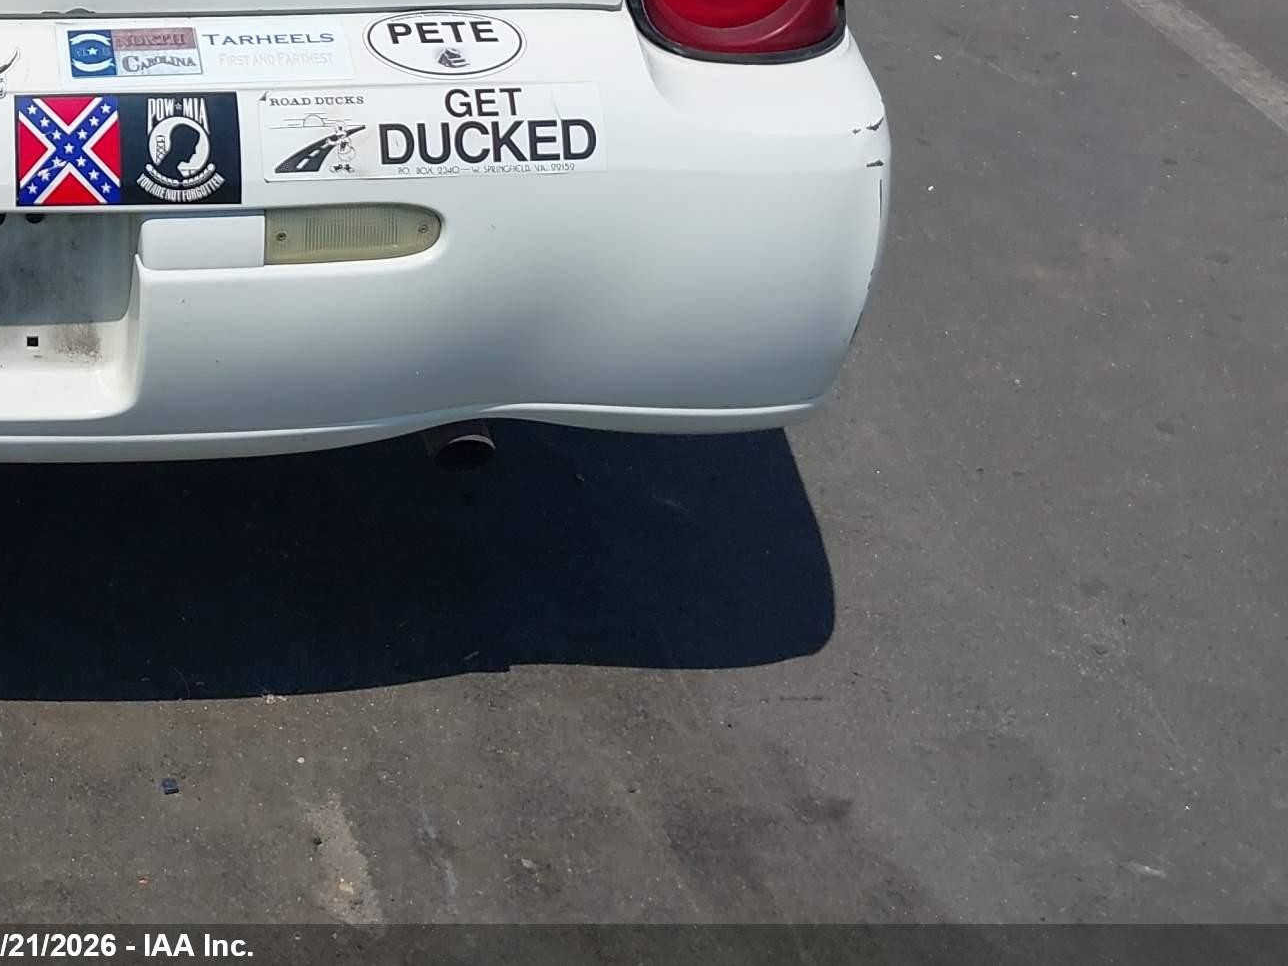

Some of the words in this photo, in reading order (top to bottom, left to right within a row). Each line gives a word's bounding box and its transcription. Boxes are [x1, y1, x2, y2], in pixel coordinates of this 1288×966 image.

[116, 32, 187, 48] NORTH
[201, 33, 335, 46] TARHEELS
[387, 20, 499, 45] PETE
[269, 96, 312, 107] ROAD
[314, 95, 365, 106] DUCKS
[444, 87, 522, 118] GET
[147, 98, 175, 135] POW
[182, 97, 210, 135] MIA
[378, 118, 597, 166] DUCKED
[550, 162, 575, 172] 22152
[136, 173, 152, 193] YOU
[149, 181, 165, 200] ARE
[164, 189, 181, 202] NOT
[181, 172, 226, 202] FORGOTTEN
